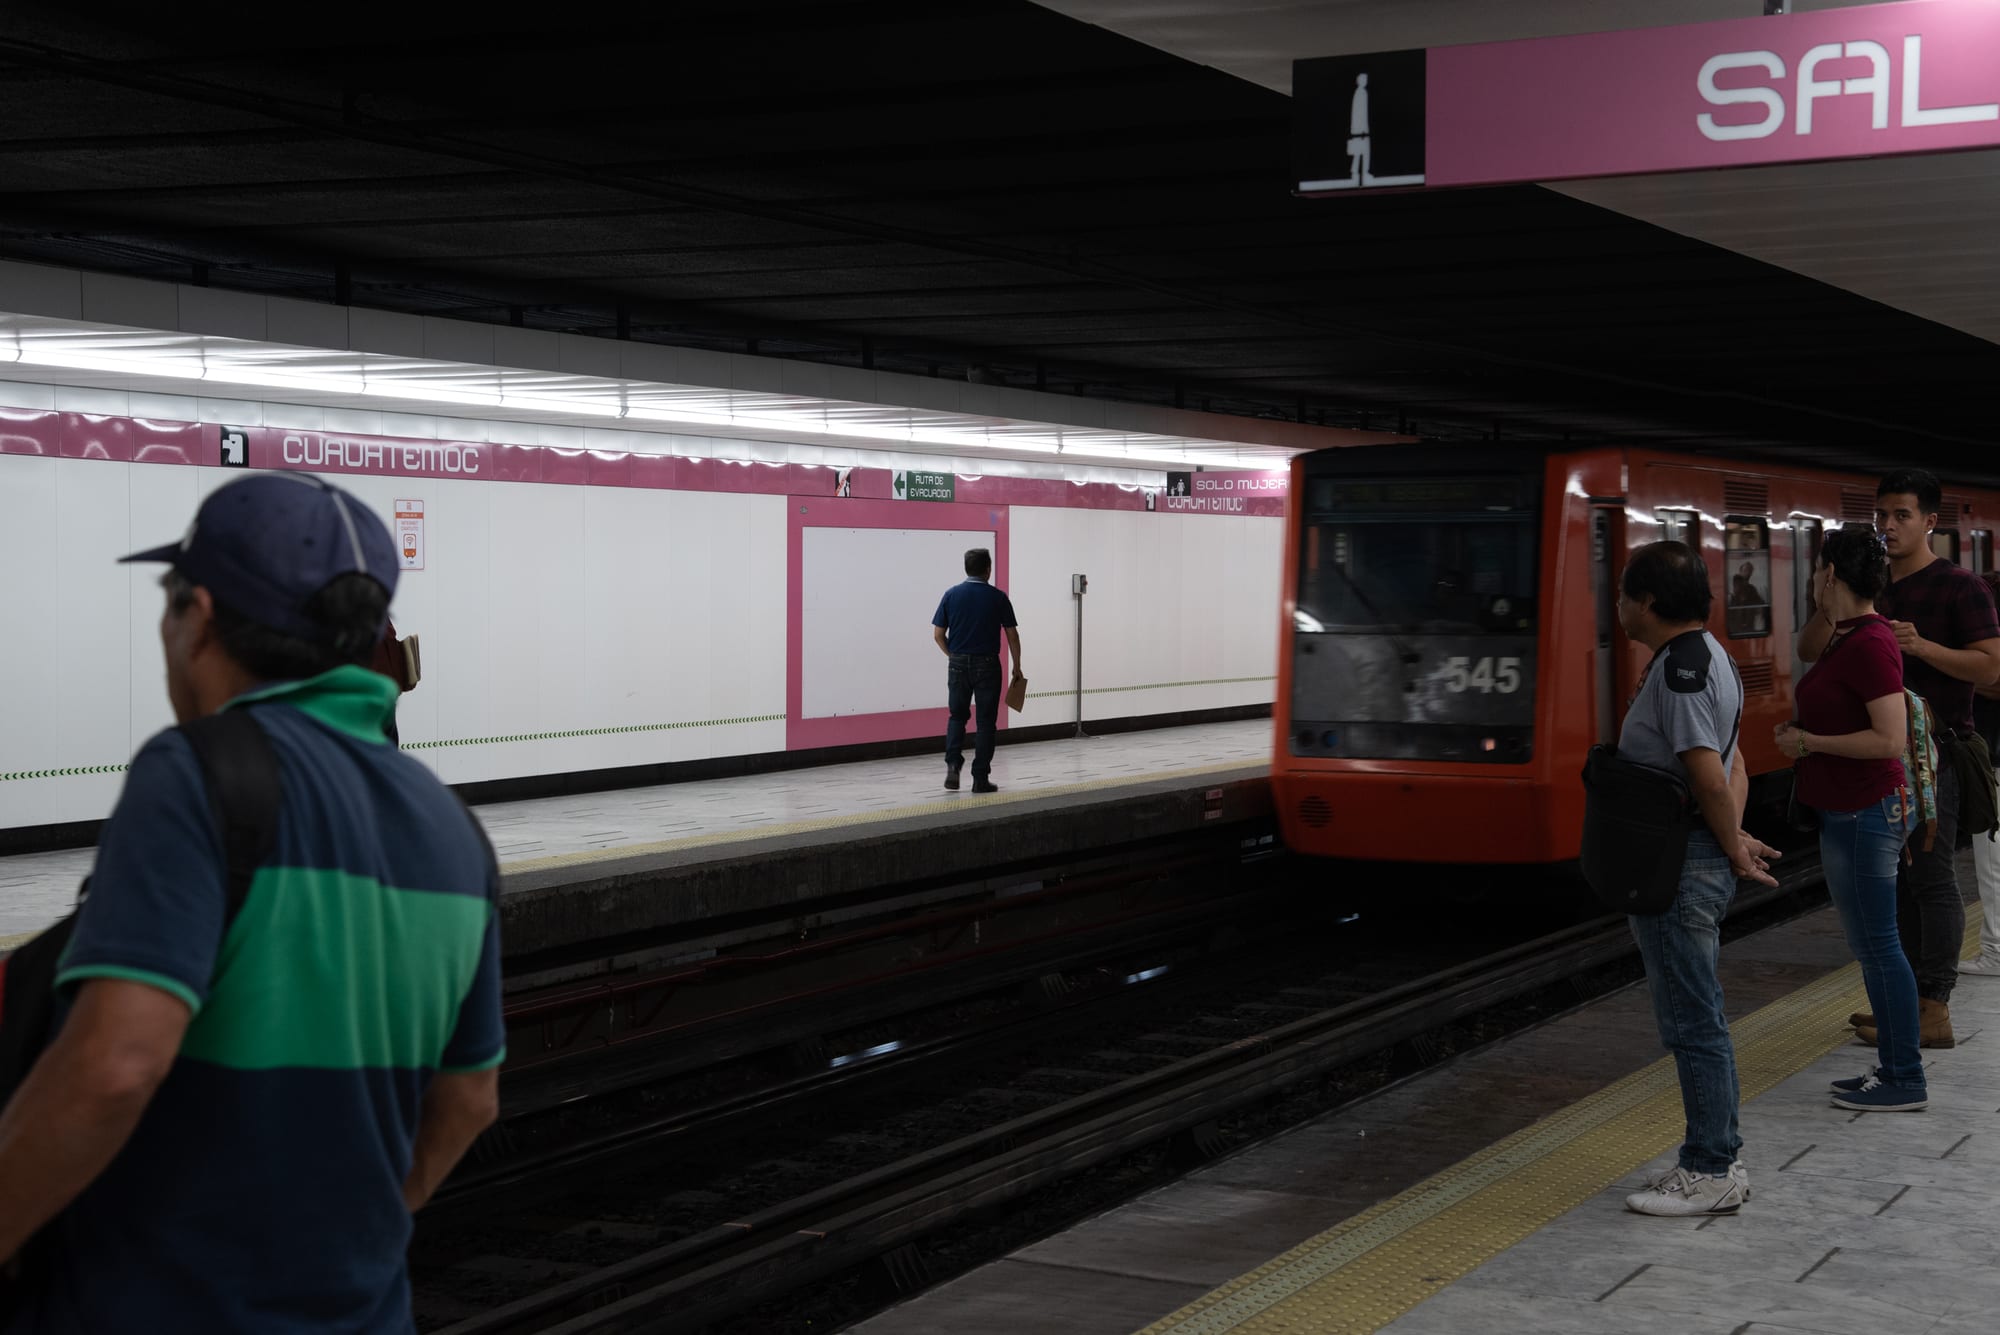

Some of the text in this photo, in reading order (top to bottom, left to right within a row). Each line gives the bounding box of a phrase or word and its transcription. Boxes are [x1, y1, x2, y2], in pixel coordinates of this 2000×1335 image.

[1697, 35, 1999, 141] SAL
[283, 436, 479, 473] CUAUHTEMOC
[915, 475, 944, 485] RUTA DE
[1196, 480, 1233, 490] SOLO
[910, 488, 951, 498] EVACUACION
[1445, 656, 1520, 694] 545
